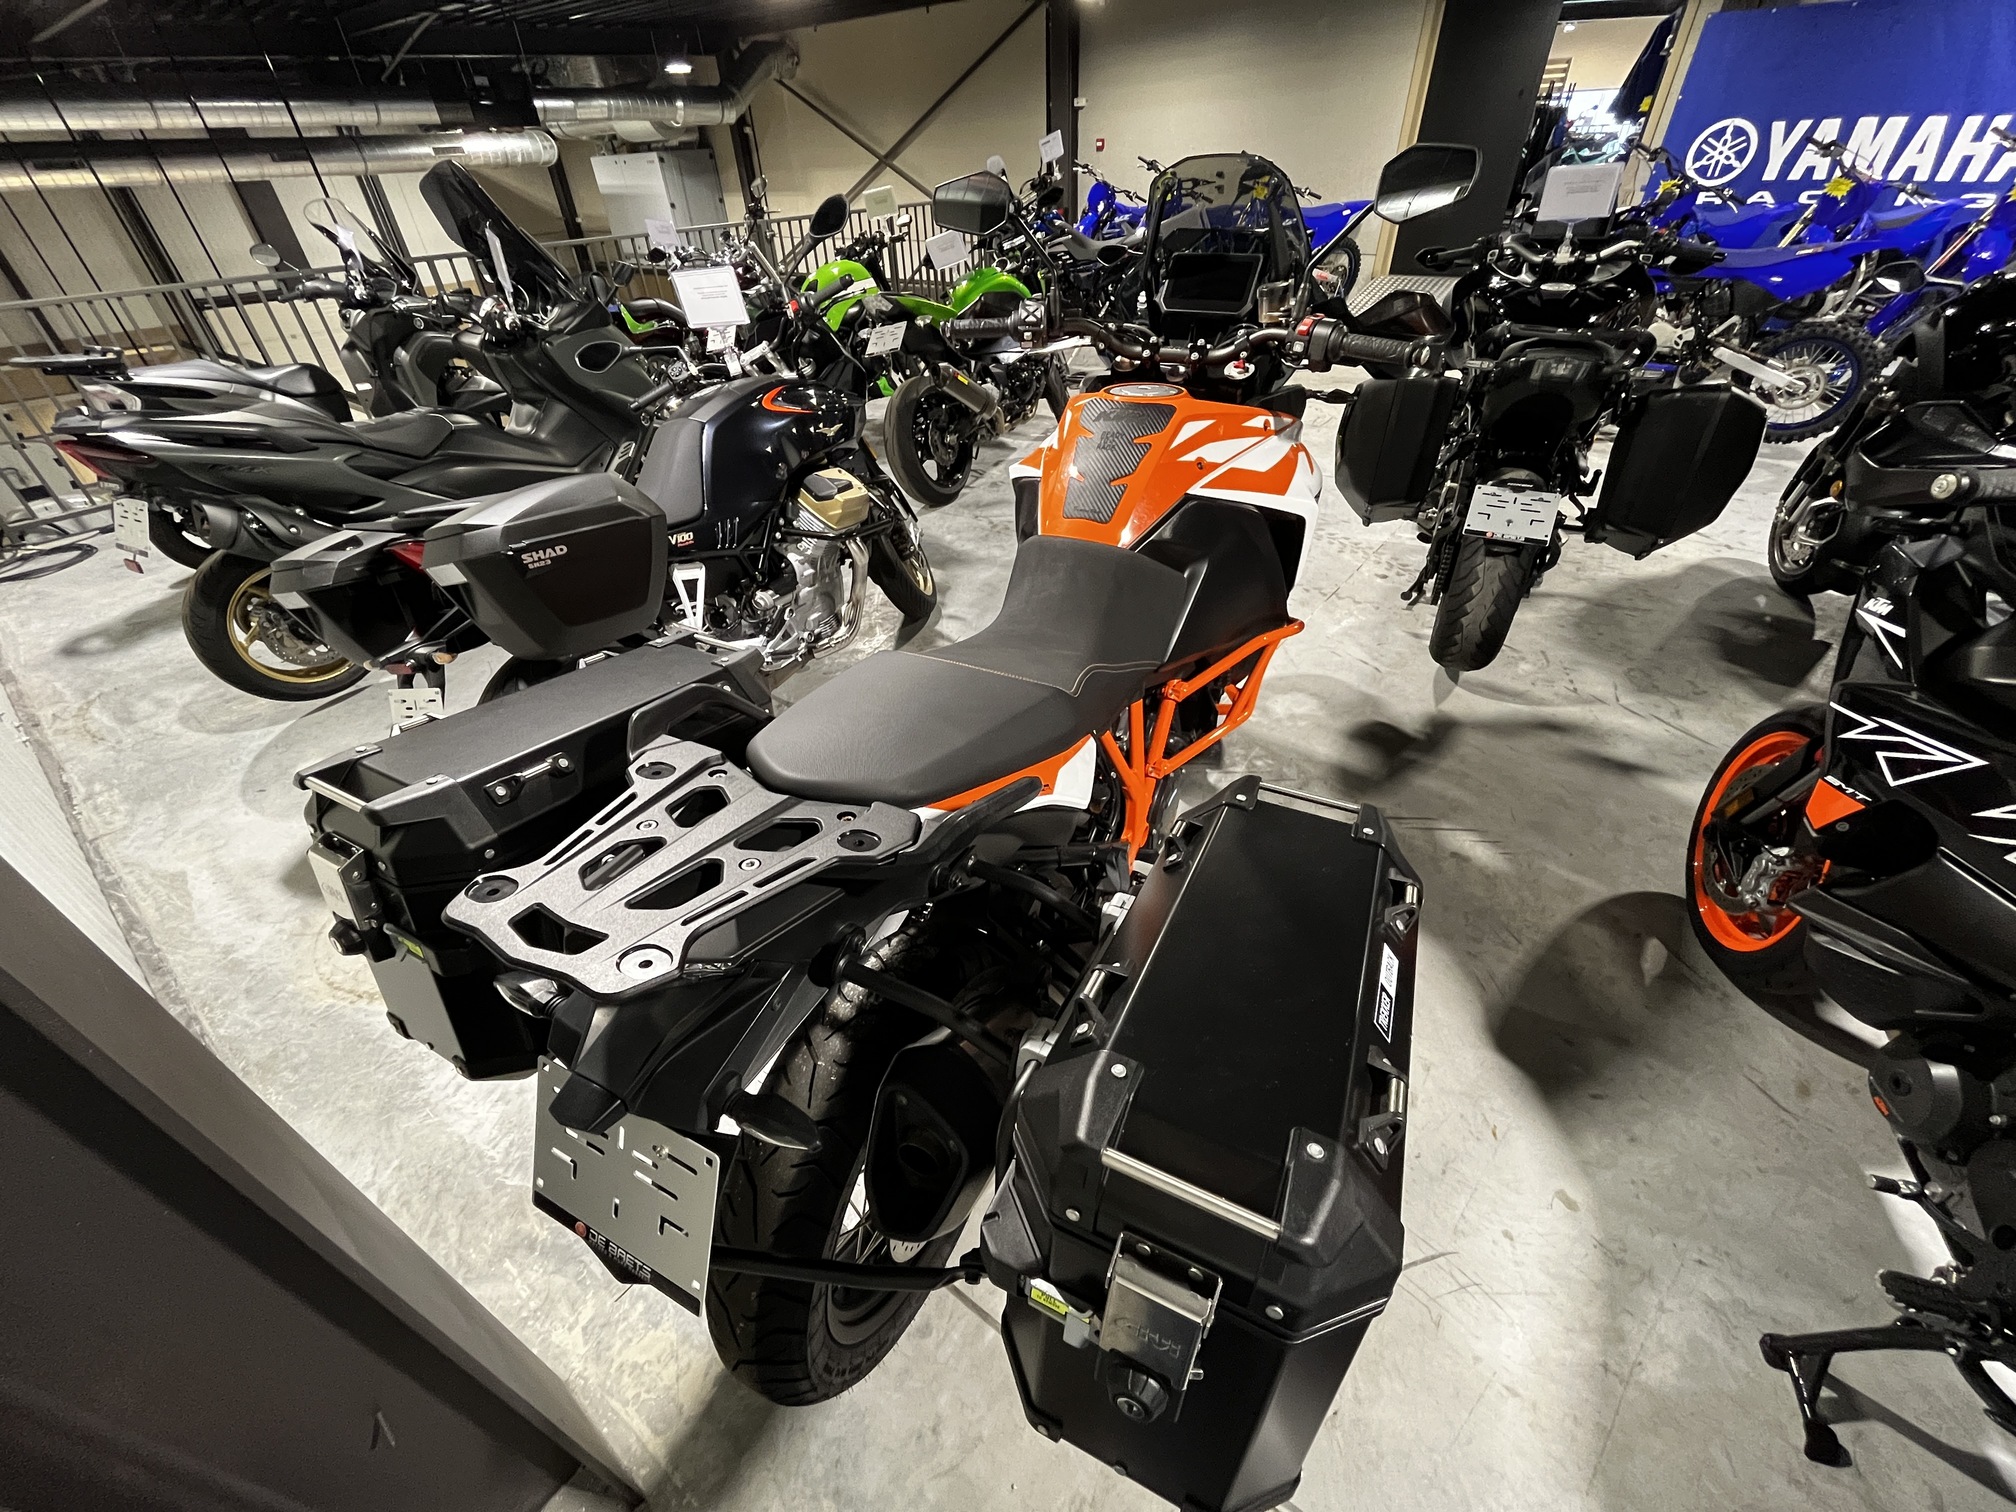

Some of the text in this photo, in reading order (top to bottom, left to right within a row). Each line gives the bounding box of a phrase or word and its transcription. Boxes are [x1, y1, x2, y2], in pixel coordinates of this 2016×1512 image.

[668, 531, 694, 546] V100
[521, 544, 568, 565] SHAD
[1863, 596, 1895, 616] KTM
[1823, 774, 1873, 802] SMT
[588, 1228, 607, 1247] DE
[608, 1242, 652, 1279] BAETS
